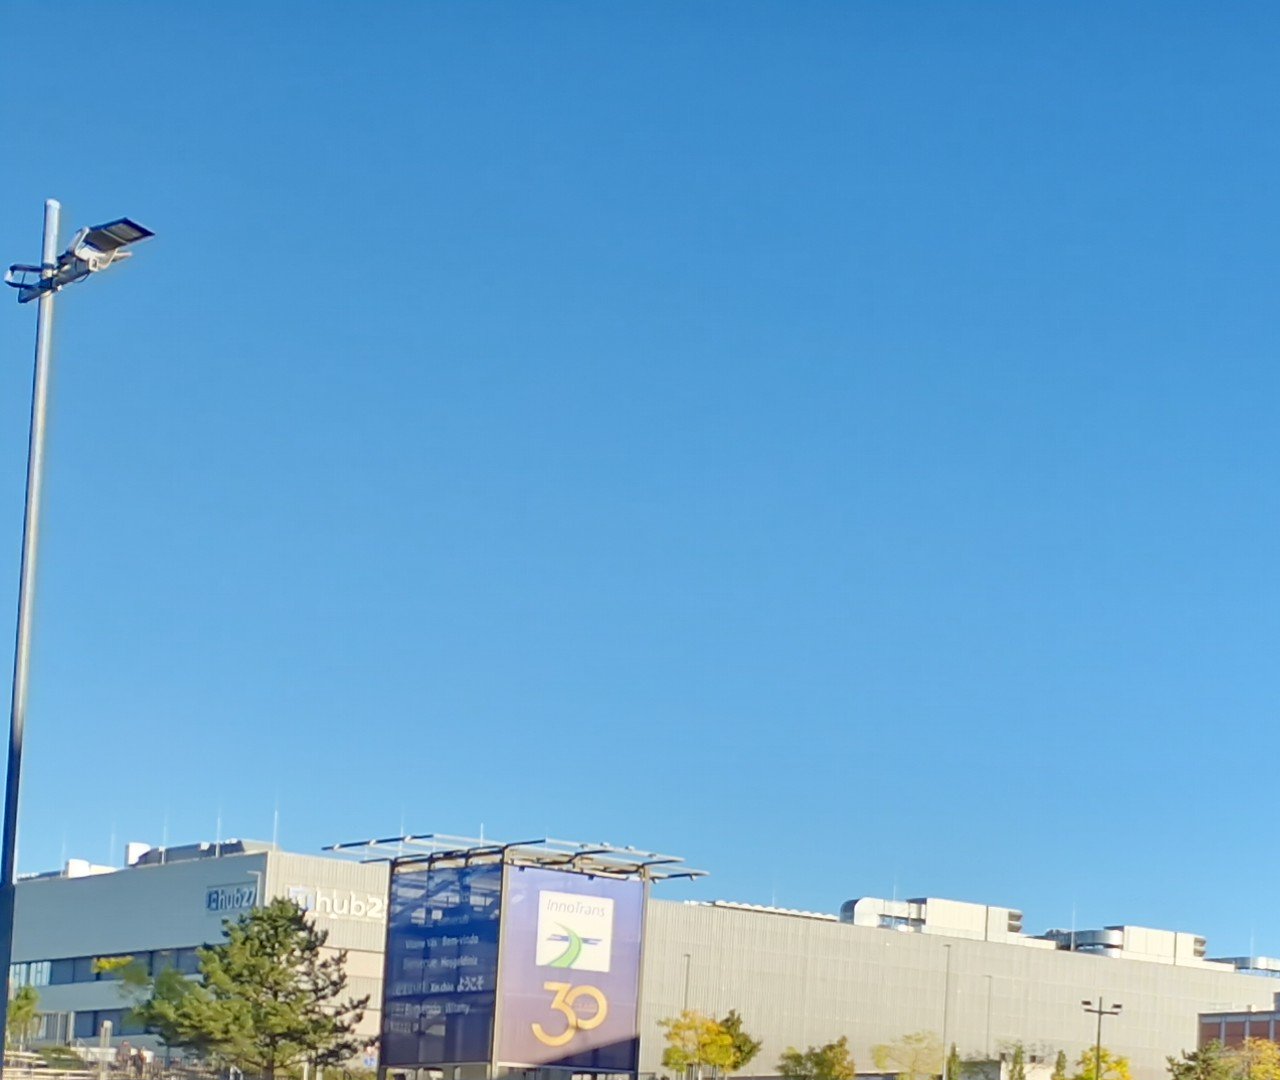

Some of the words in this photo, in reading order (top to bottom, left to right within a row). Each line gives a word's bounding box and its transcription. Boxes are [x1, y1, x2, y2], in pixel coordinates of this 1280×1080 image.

[316, 886, 387, 918] hub2
[546, 899, 606, 917] InnoTrans
[532, 981, 608, 1048] 30
